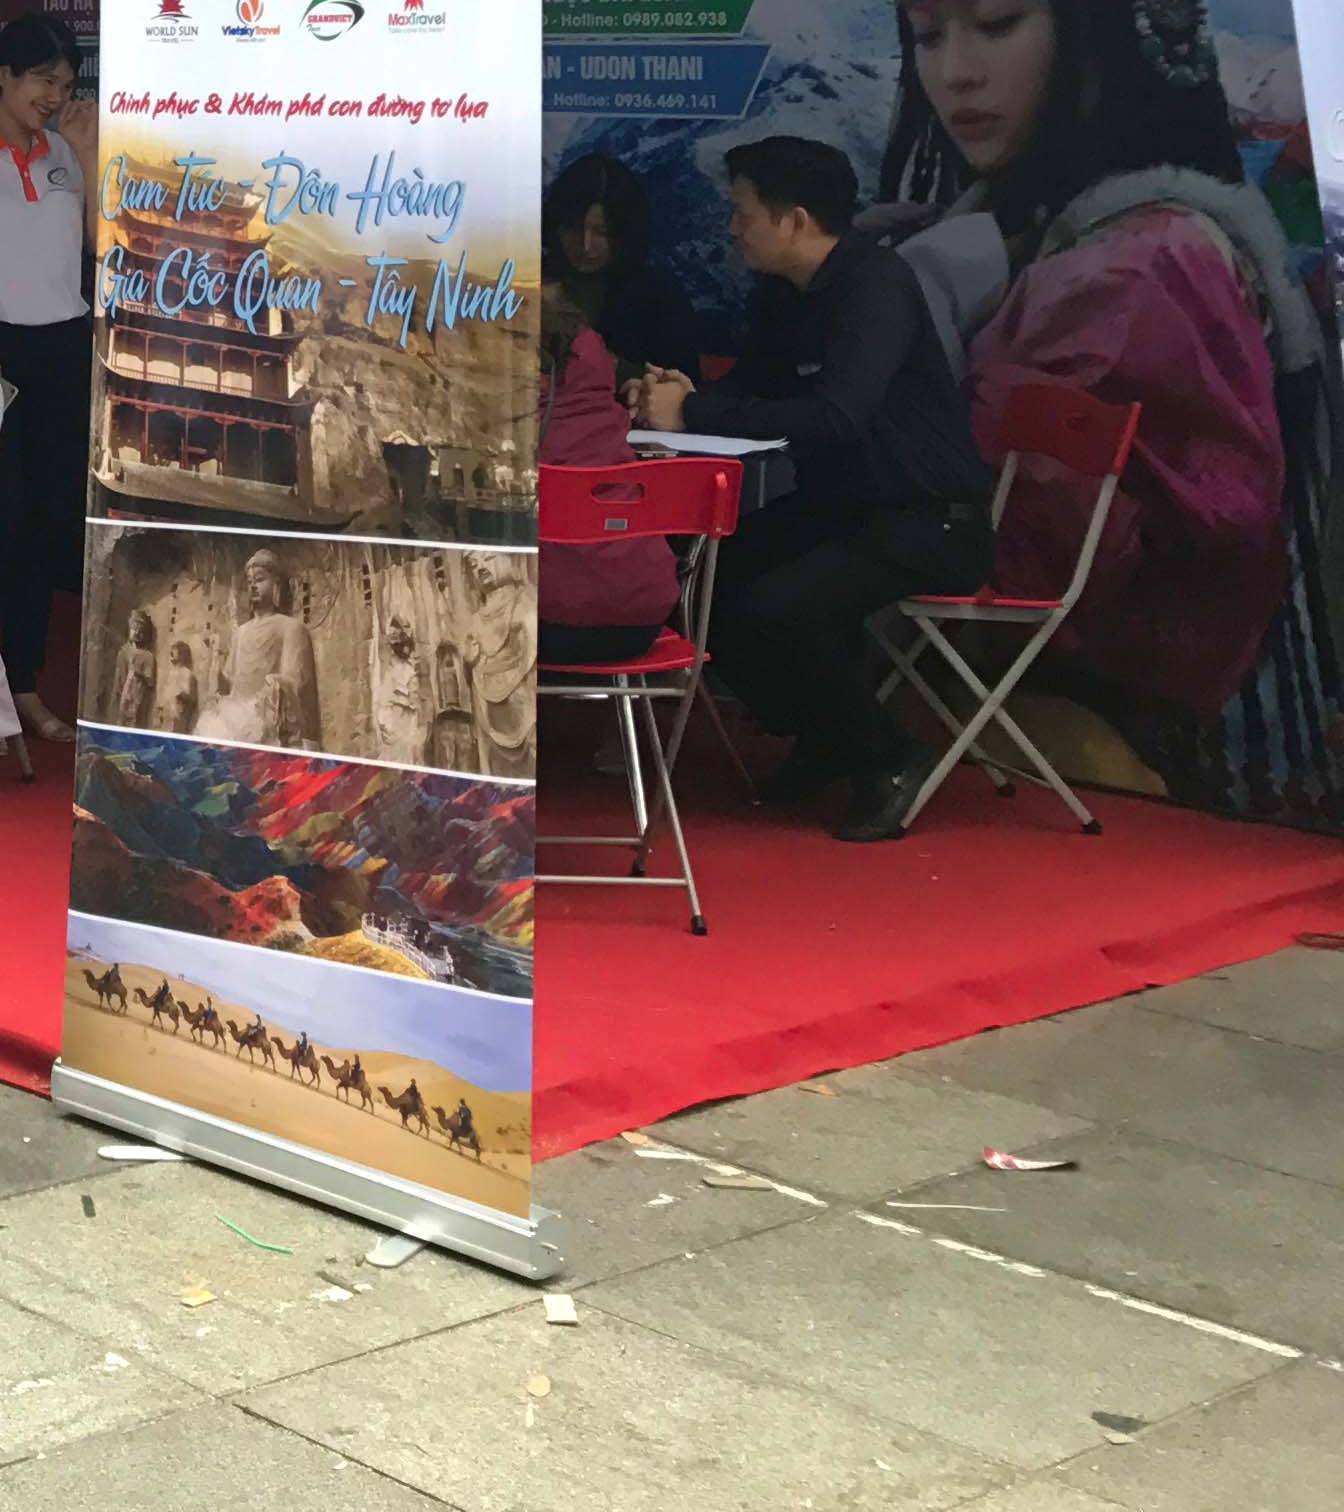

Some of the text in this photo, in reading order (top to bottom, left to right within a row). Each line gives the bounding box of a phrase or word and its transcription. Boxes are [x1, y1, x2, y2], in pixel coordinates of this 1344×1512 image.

[388, 12, 446, 27] MaxTravel
[561, 14, 618, 28] Hotline:
[145, 25, 199, 37] WORLD SUN
[580, 56, 703, 81] UDON THANI
[153, 91, 198, 120] phục
[204, 93, 222, 114] &
[228, 91, 282, 116] Khám
[286, 93, 322, 122] phá
[328, 99, 362, 117] con
[367, 93, 425, 124] đường
[430, 95, 452, 118] tơ
[454, 93, 488, 123] lụa
[553, 92, 716, 109] Hotline: 0936.469.141
[102, 149, 466, 243] Cam Túc Đôn Hoàng
[98, 245, 524, 350] Gia Cốc Quan Tây Ninh
